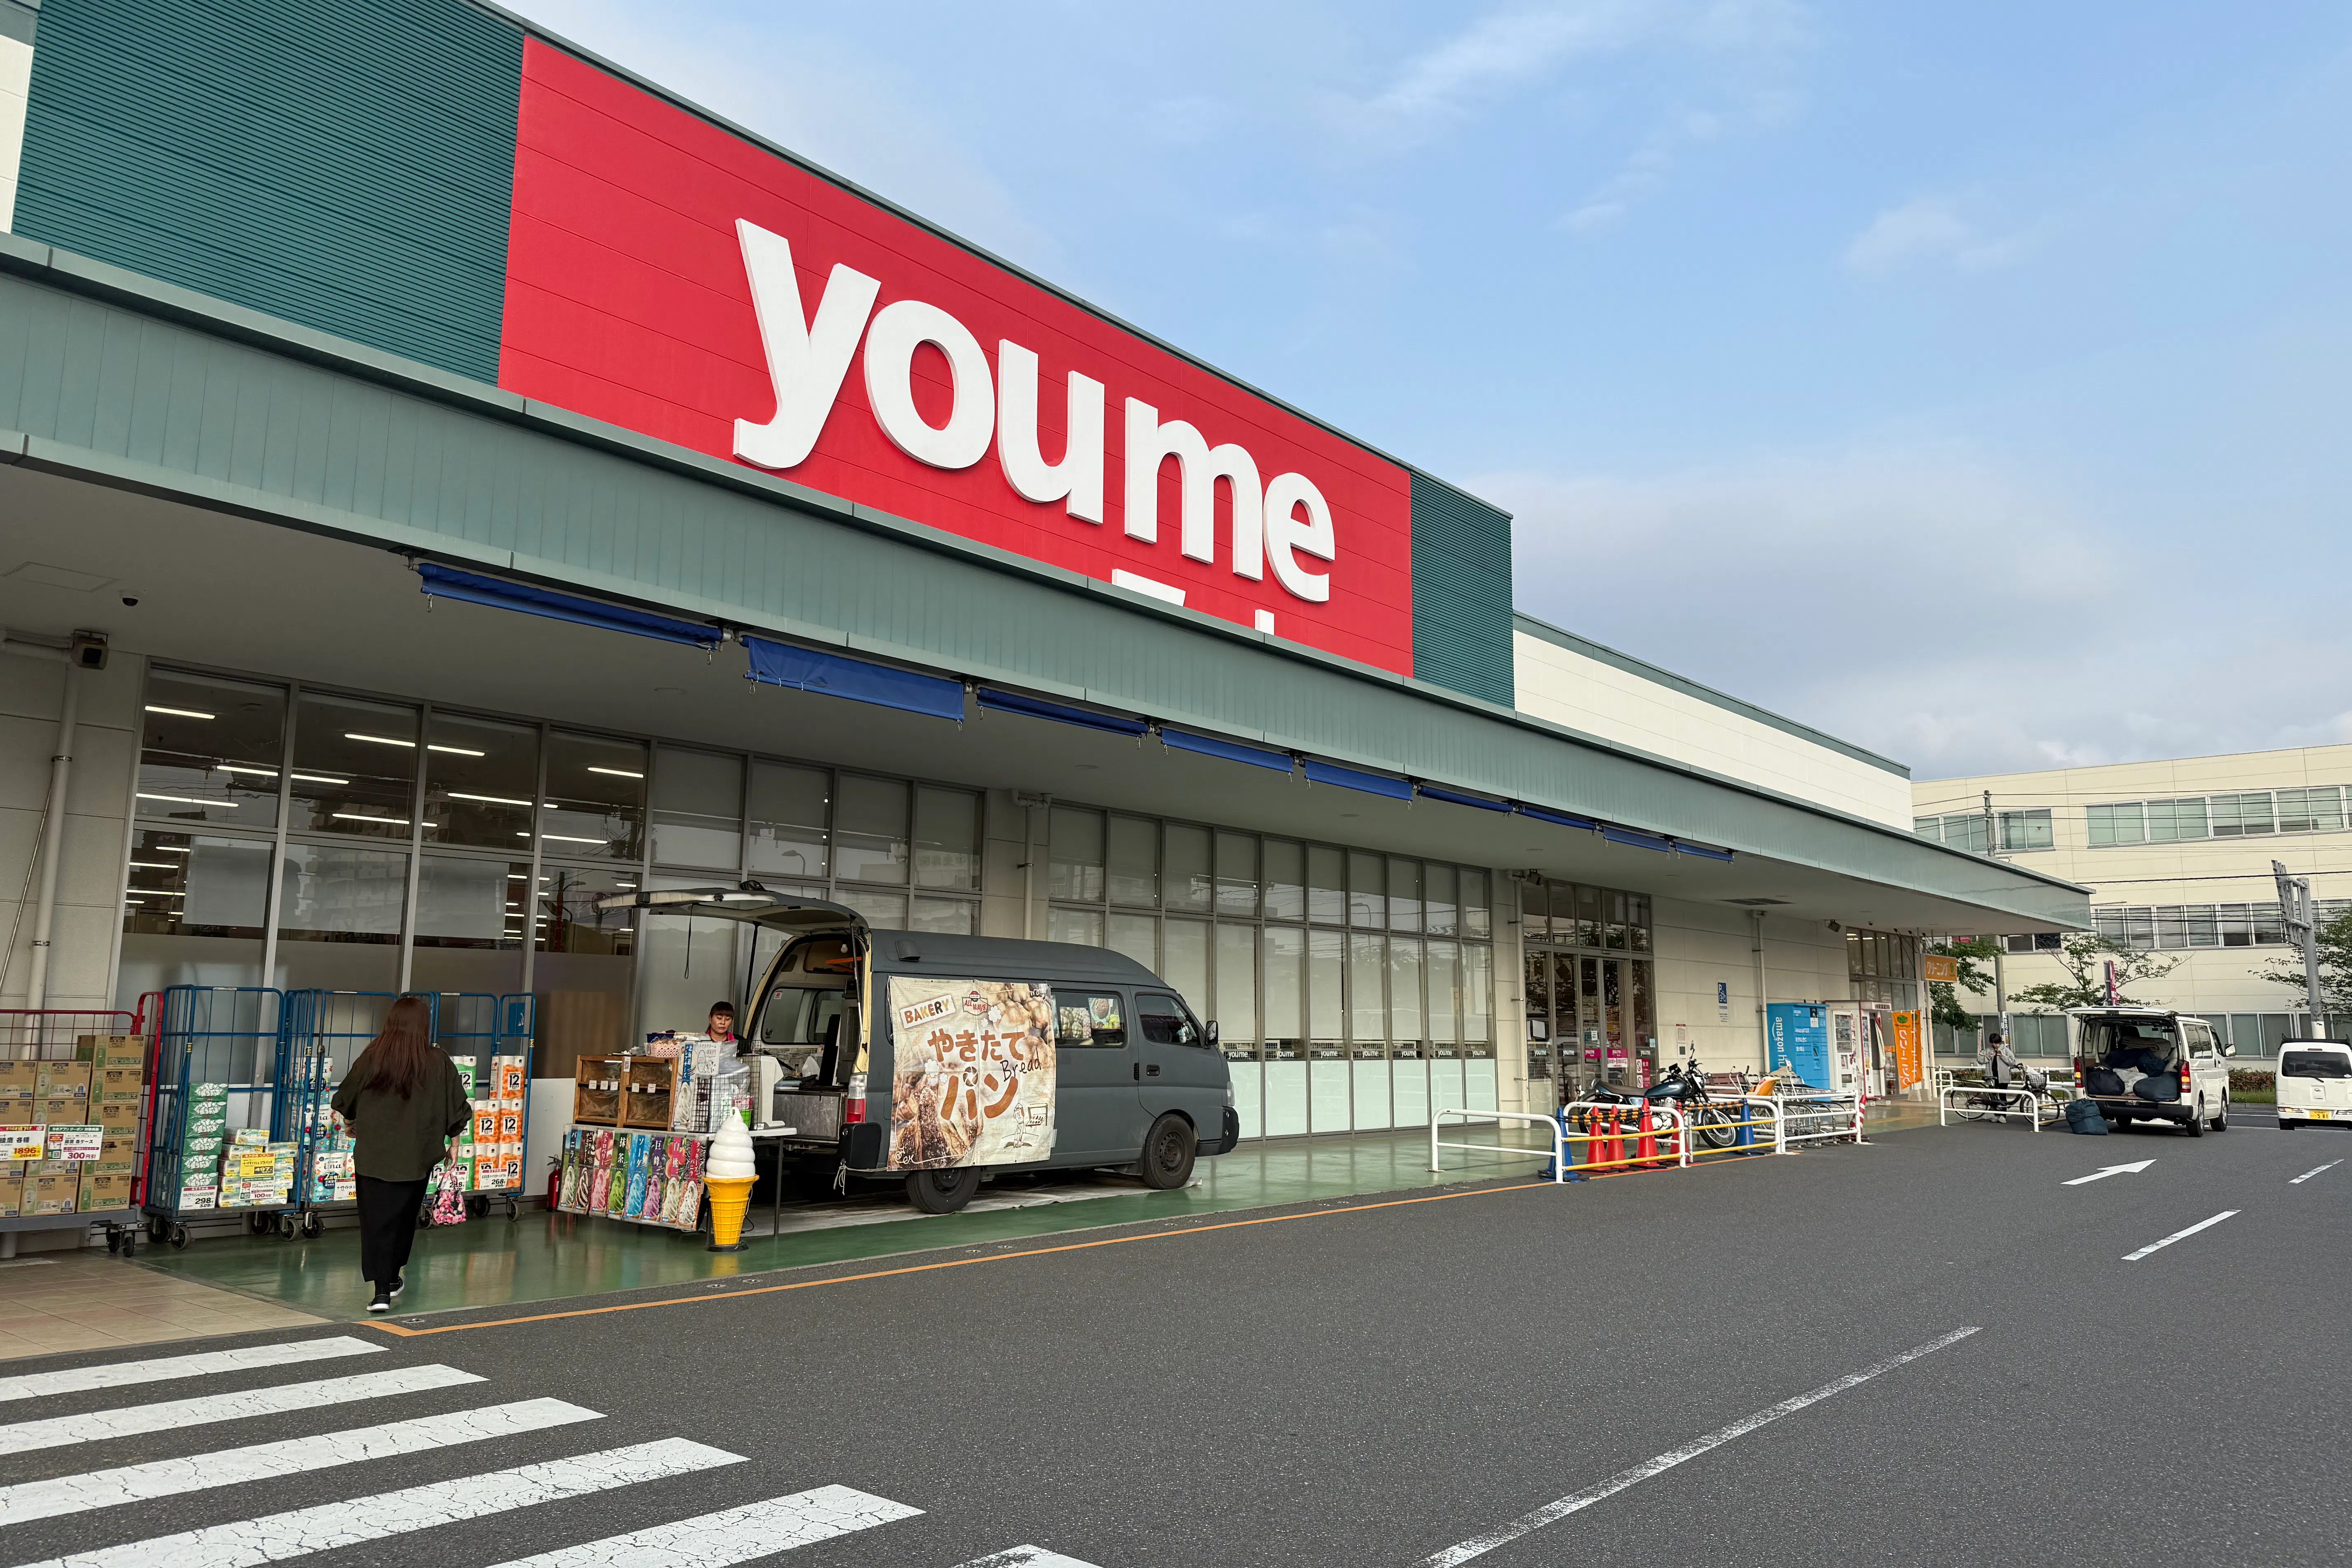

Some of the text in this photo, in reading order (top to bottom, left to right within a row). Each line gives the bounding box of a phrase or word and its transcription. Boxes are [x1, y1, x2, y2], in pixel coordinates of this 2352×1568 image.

[1927, 961, 1948, 976] クリーニング
[904, 999, 949, 1024] BAKERY
[1776, 1017, 1785, 1052] amazon
[927, 1028, 1025, 1062] やきたて
[1228, 1051, 1248, 1059] youme
[1000, 1047, 1041, 1082] Bread
[509, 1075, 520, 1087] 12
[940, 1066, 1018, 1121] パン
[481, 1119, 493, 1133] 12
[505, 1118, 516, 1132] 12
[618, 1137, 626, 1163] 抹茶
[508, 1163, 518, 1176] 12
